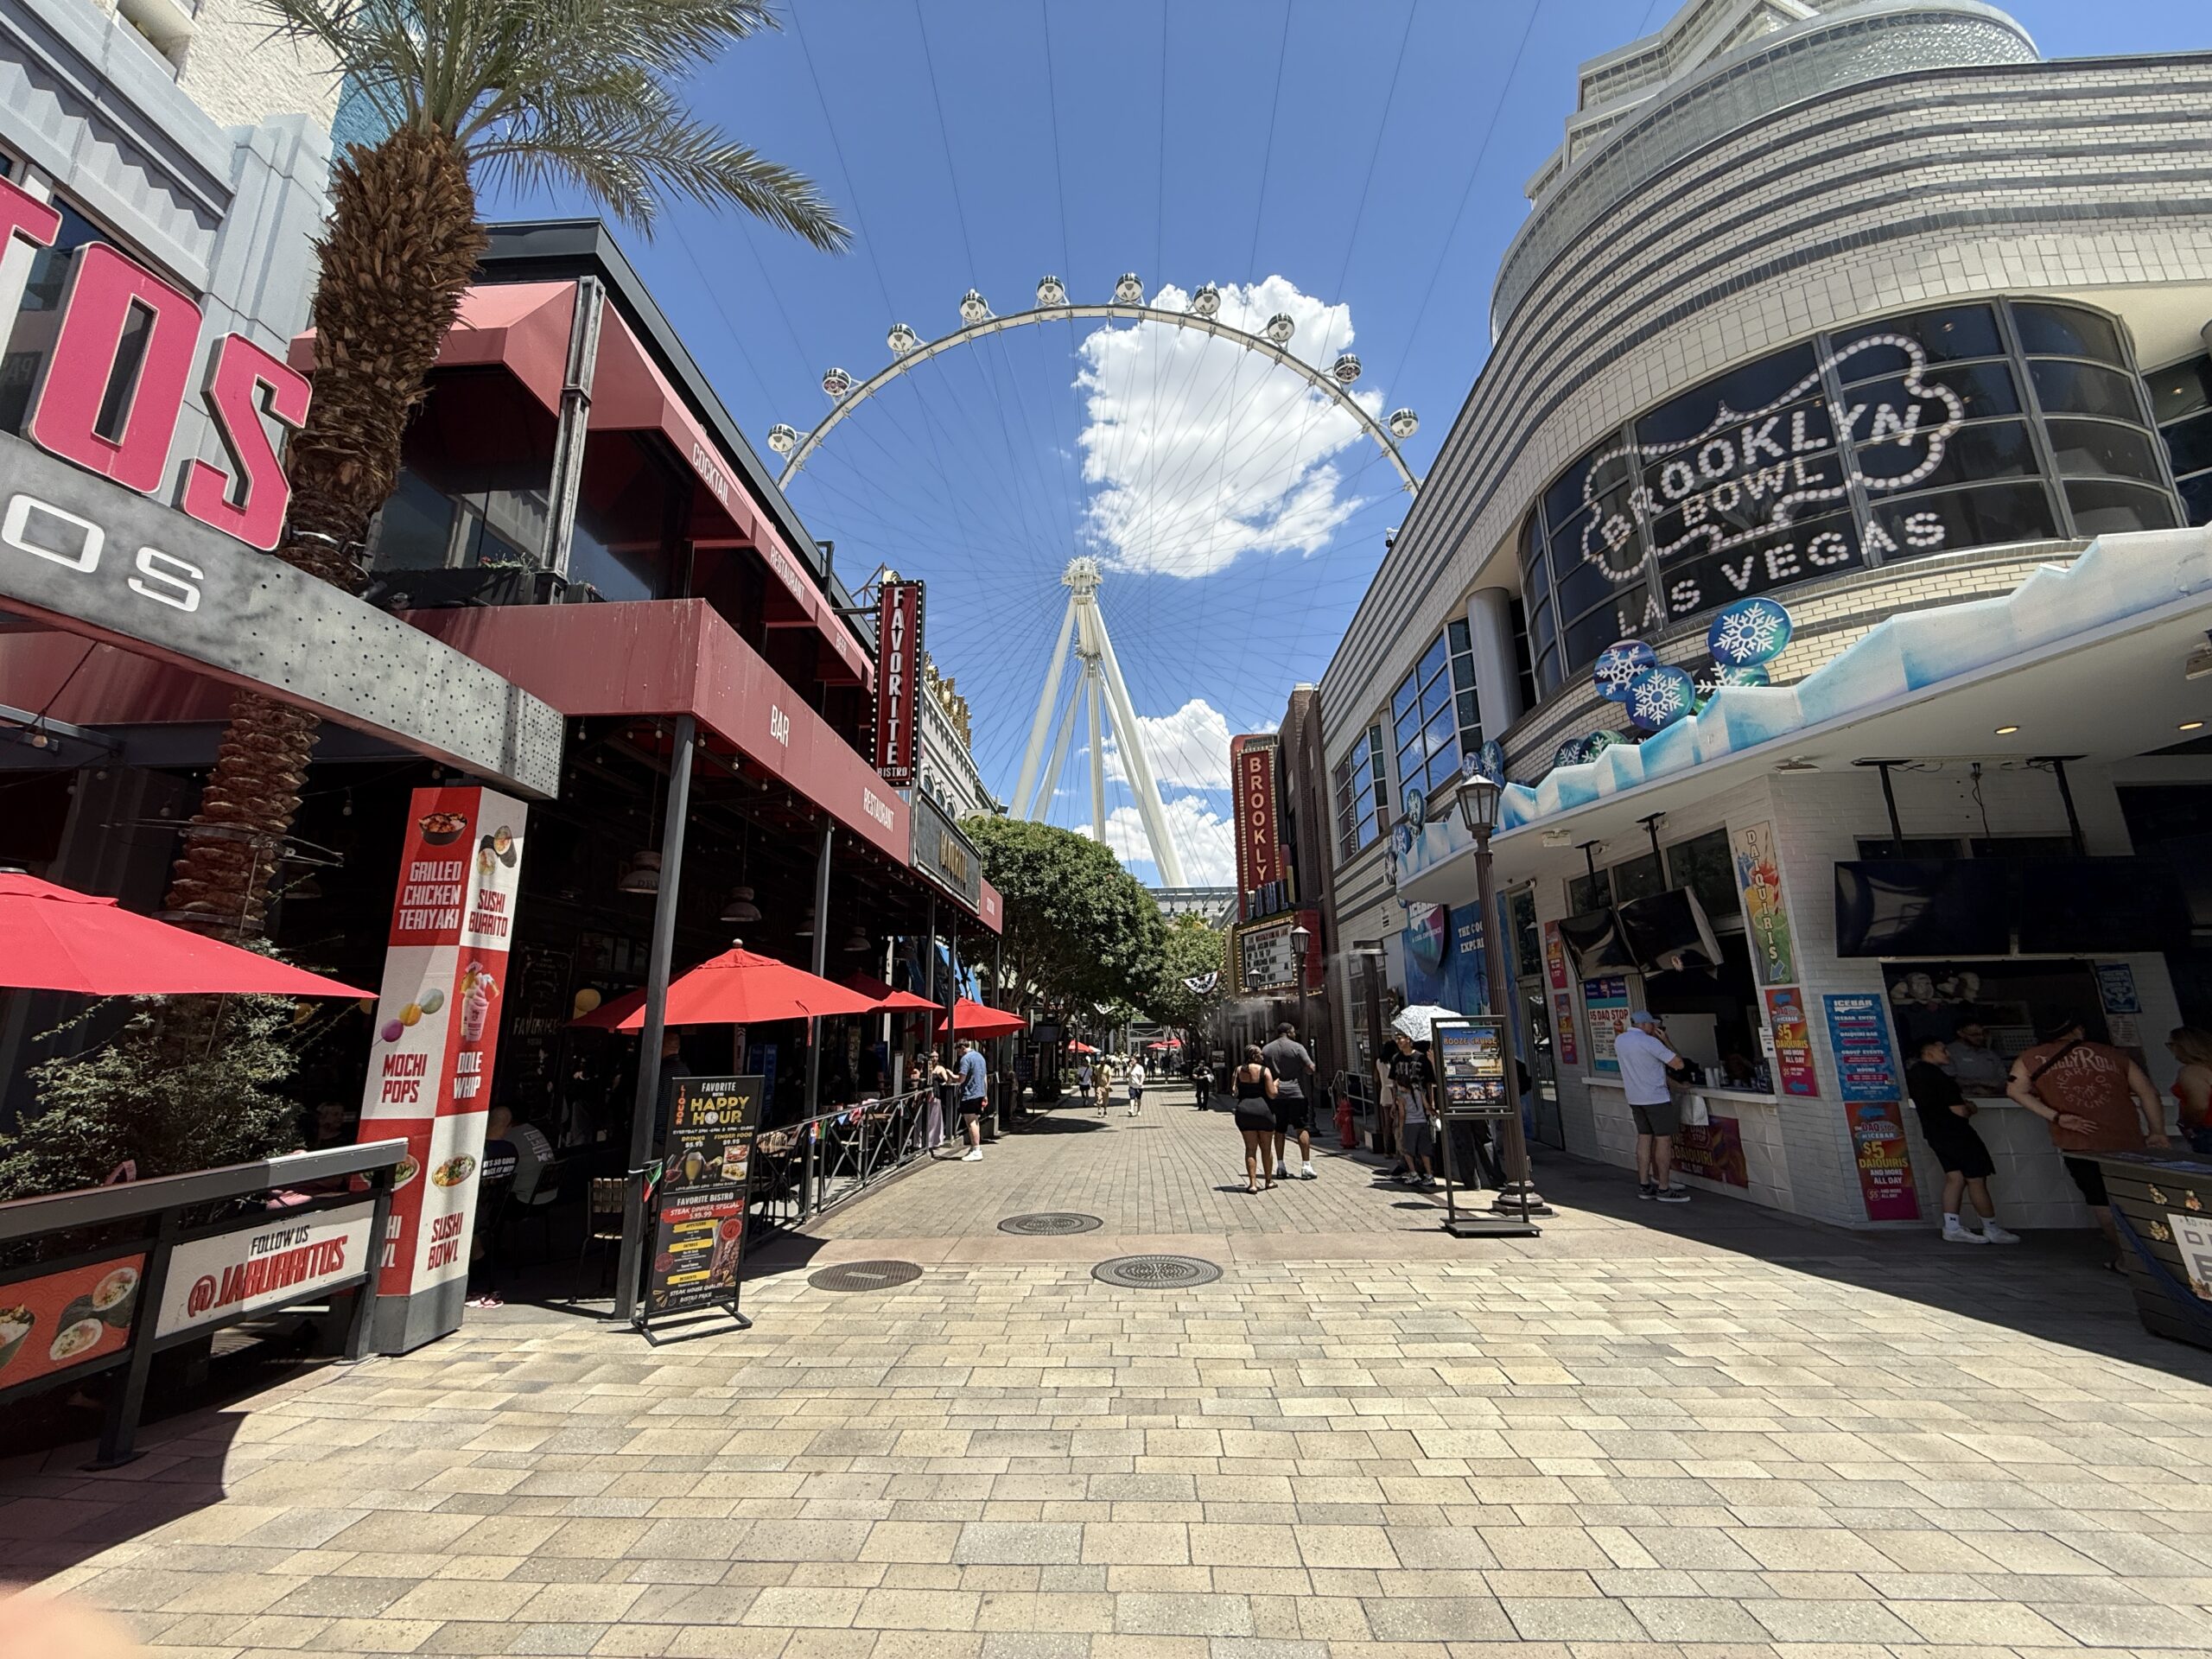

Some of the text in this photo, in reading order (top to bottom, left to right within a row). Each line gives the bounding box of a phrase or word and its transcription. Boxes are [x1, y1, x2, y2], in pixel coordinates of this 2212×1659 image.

[692, 442, 729, 507] COCKTAIL
[1601, 404, 1922, 553] BROOKLYN
[1681, 457, 1824, 528] BOWL
[770, 547, 805, 602] RESTAURANT
[1618, 512, 1945, 638] LAS VEGAS
[836, 632, 847, 658] BEER
[887, 586, 906, 766] FAVORITE
[770, 703, 790, 747] BAR
[877, 766, 907, 778] BISTRO
[863, 787, 895, 833] RESTAURANT
[1249, 757, 1268, 889] BROOKLY
[410, 861, 463, 882] GRILLED
[403, 884, 461, 906] CHICKEN
[477, 888, 506, 913] SUSHI
[1745, 830, 1778, 960] DAIQUIRIS
[398, 909, 460, 931] TERIYAKI
[467, 911, 509, 938] BURRITO
[1458, 925, 1470, 938] THE
[1598, 1009, 1611, 1020] DAQ
[1611, 1008, 1629, 1020] STOP
[1777, 1023, 1793, 1040] $5
[1776, 1039, 1808, 1049] DAIQUIRIS
[382, 1053, 428, 1077] MOCHI
[456, 1052, 484, 1074] DOLE
[1795, 1055, 1805, 1064] DAY
[454, 1077, 481, 1099] WHIP
[701, 1082, 736, 1092] FAVORITE
[2056, 1067, 2094, 1090] HEART
[382, 1079, 420, 1103] POPS
[690, 1096, 750, 1111] HAPPY
[1861, 1122, 1880, 1132] DAQ
[1863, 1141, 1885, 1159] $5
[1859, 1158, 1909, 1170] DAIQUIRIS
[1888, 1176, 1903, 1185] DAY
[670, 1200, 741, 1217] STEAK DINNER SPECIAL
[677, 1192, 734, 1206] FAVORITE BISTRO
[432, 1211, 463, 1243] SUSHI
[250, 1224, 310, 1256] FOLLOW US
[427, 1238, 459, 1271] BOWL
[188, 1235, 348, 1318] @JABURRITOS
